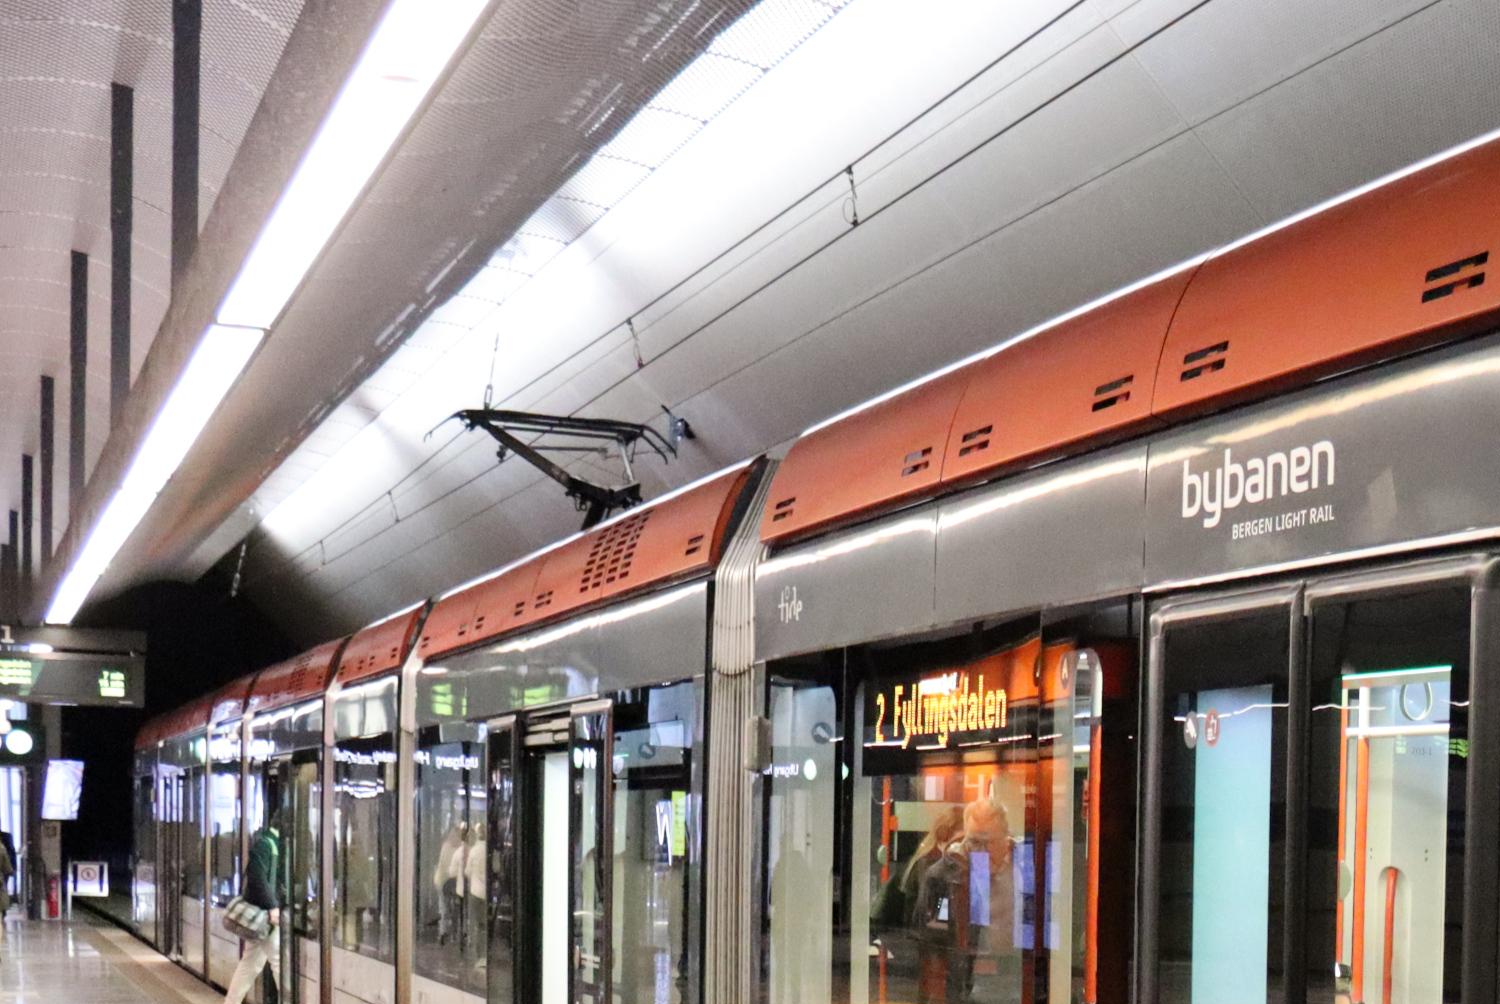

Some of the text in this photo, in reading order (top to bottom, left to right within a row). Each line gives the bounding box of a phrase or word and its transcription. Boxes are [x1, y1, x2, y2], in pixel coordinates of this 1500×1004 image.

[1181, 440, 1336, 529] bybanen
[1232, 504, 1336, 540] BERGEN LIGHT RAIL
[875, 674, 1008, 750] 2 Fyllingsdalen
